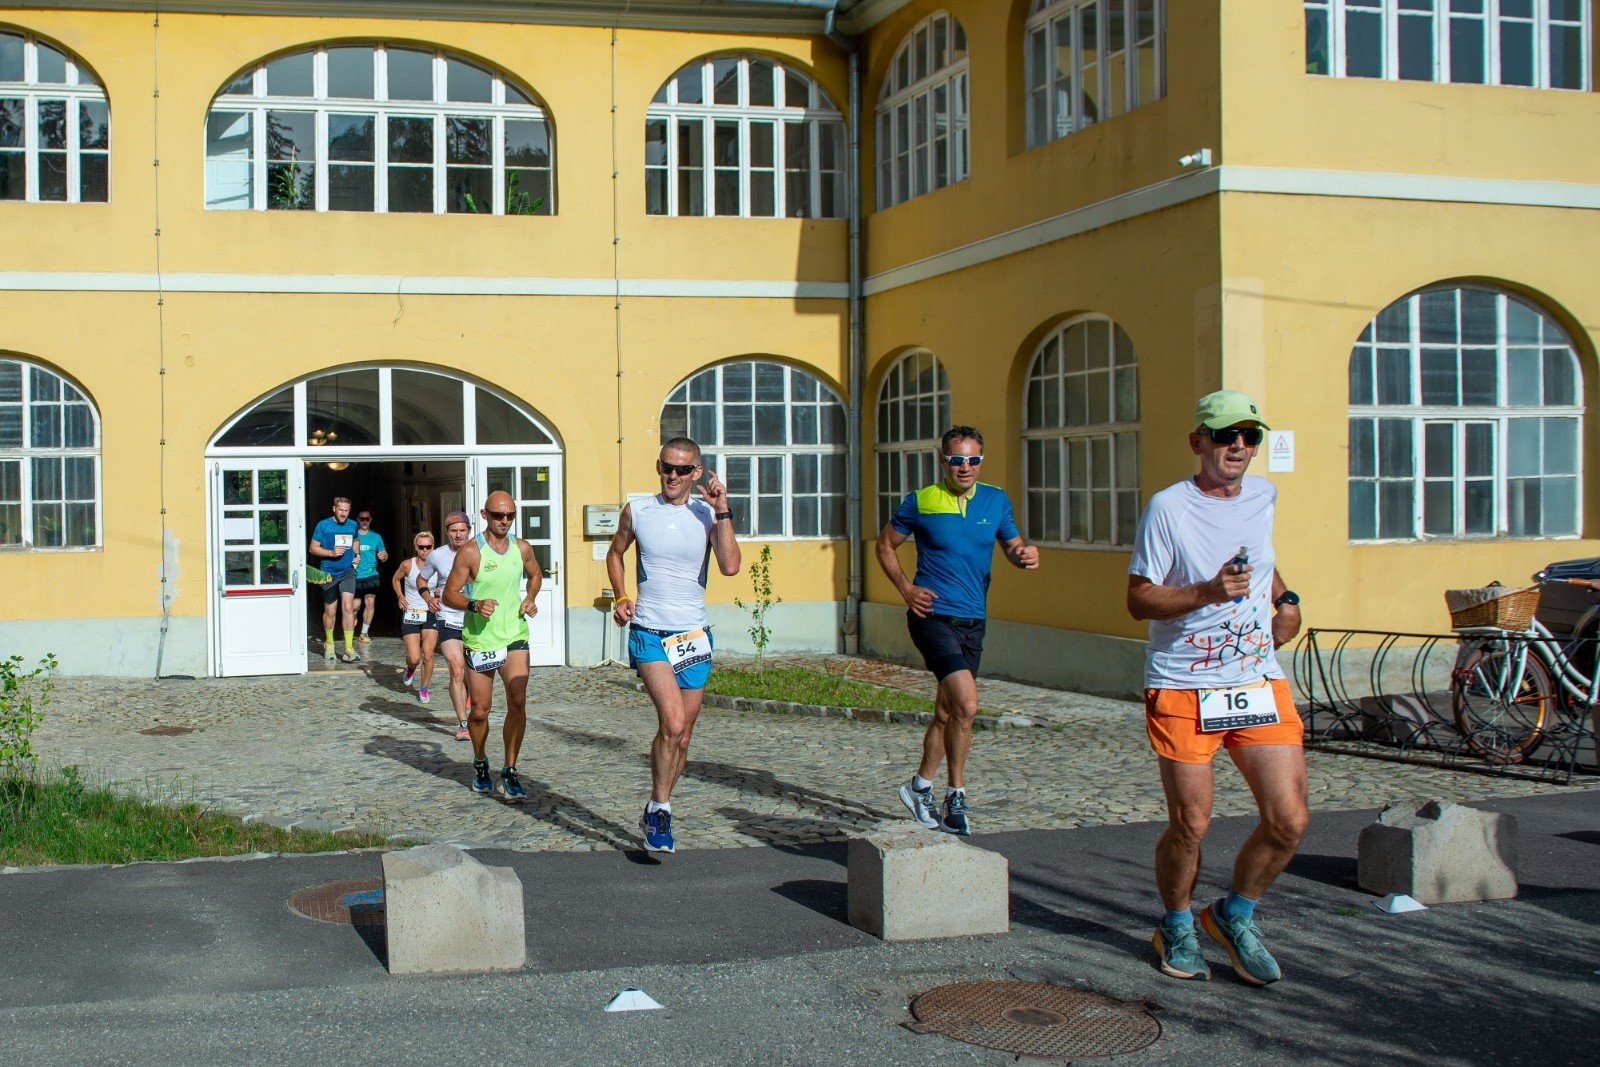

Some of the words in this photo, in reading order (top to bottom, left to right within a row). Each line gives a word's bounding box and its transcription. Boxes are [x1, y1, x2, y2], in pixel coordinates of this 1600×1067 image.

[410, 612, 420, 620] 53
[676, 641, 697, 657] 54
[480, 651, 497, 661] 38
[1223, 692, 1249, 711] 16
